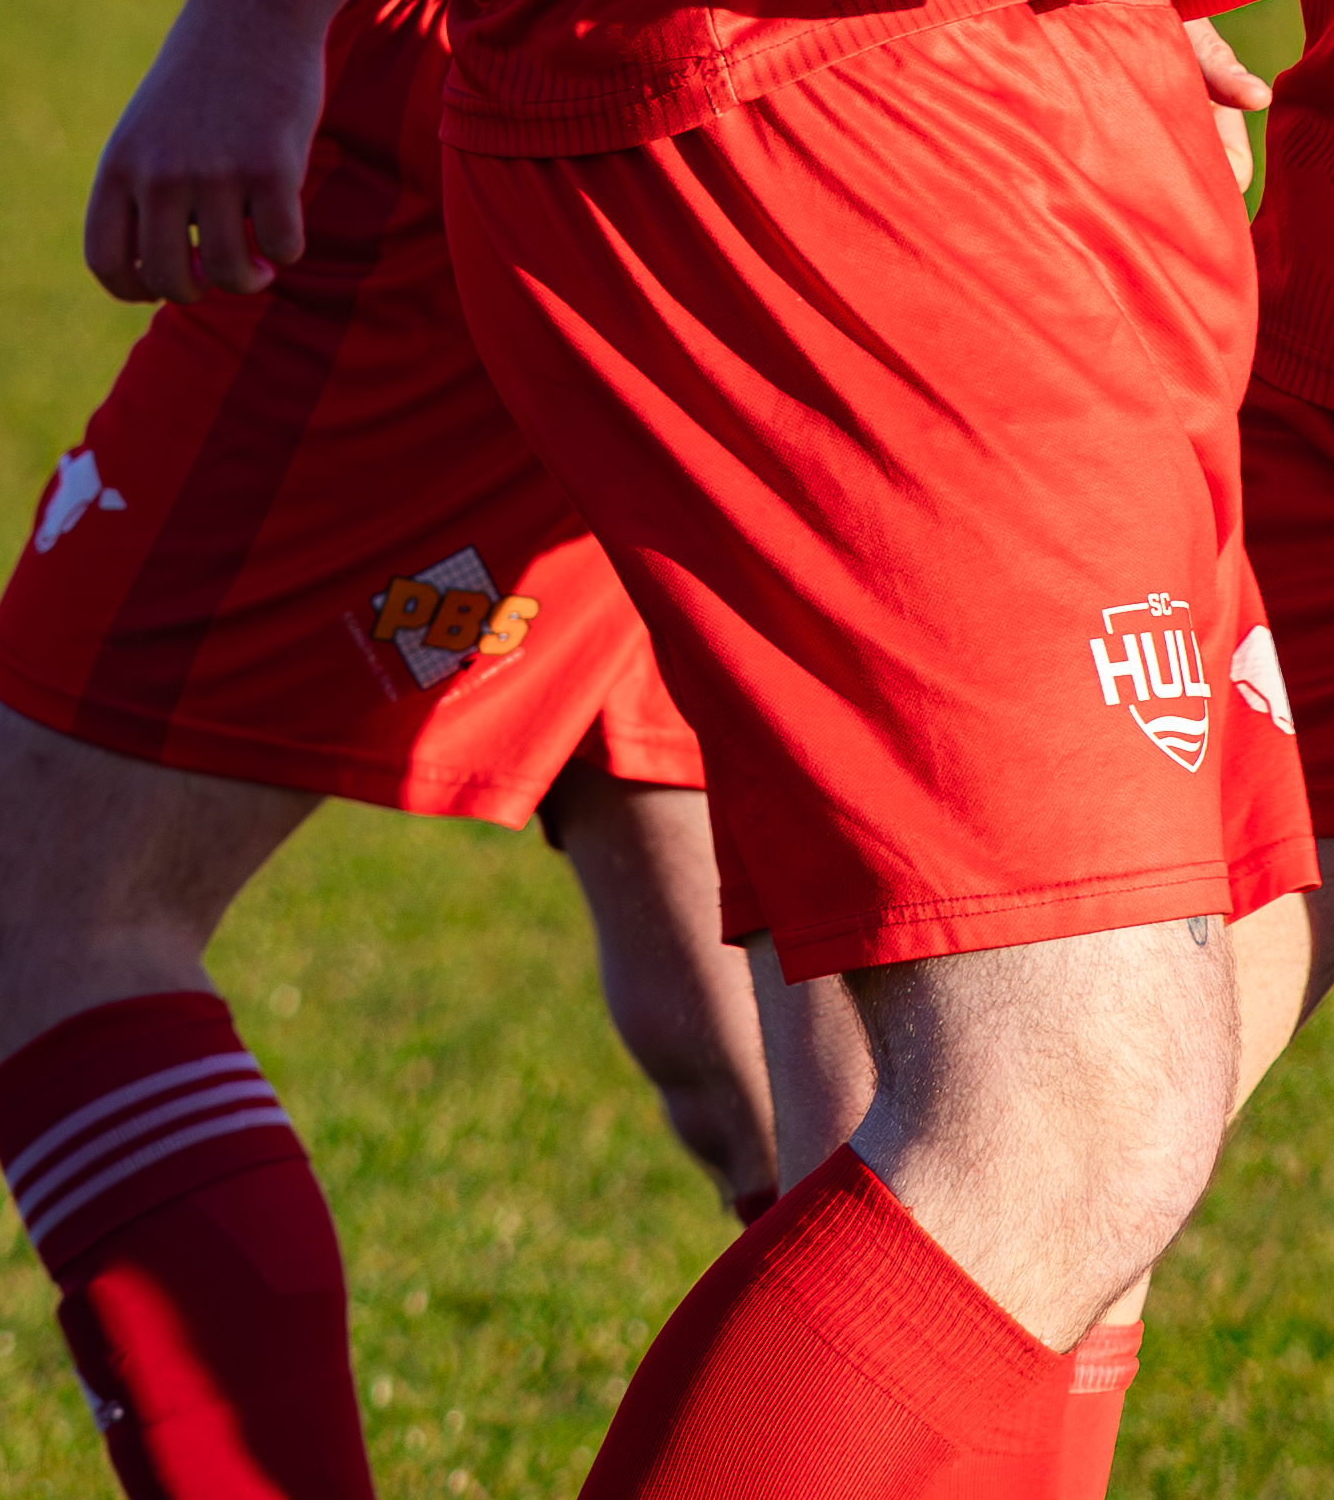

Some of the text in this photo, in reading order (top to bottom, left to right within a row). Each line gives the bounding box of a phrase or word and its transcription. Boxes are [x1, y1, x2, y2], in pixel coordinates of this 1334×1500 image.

[370, 575, 541, 656] PBS
[1147, 592, 1173, 617] SC
[1089, 629, 1212, 706] HULL
